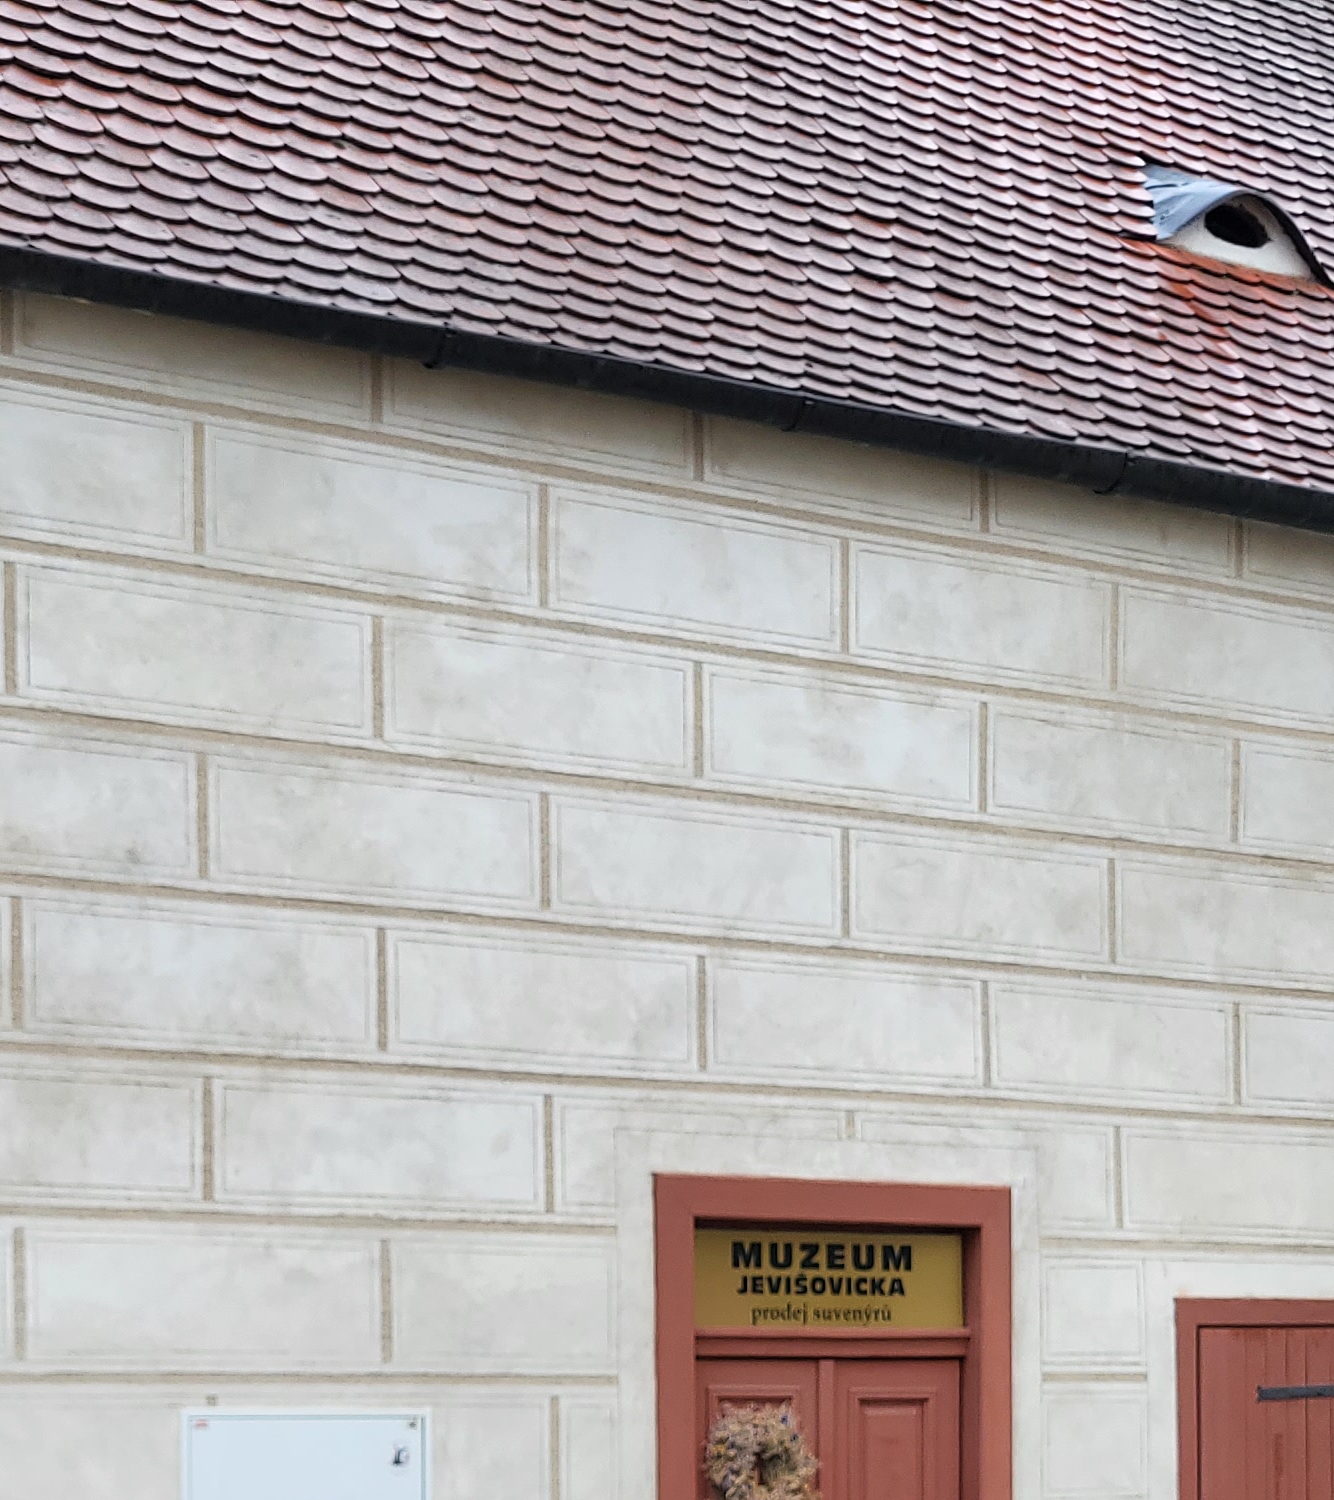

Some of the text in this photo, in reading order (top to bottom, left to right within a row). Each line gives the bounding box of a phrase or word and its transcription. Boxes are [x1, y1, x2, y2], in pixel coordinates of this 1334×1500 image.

[732, 1241, 912, 1271] MUZEUM
[737, 1273, 906, 1297] JEVIŠOVICKA
[751, 1301, 809, 1326] prodej
